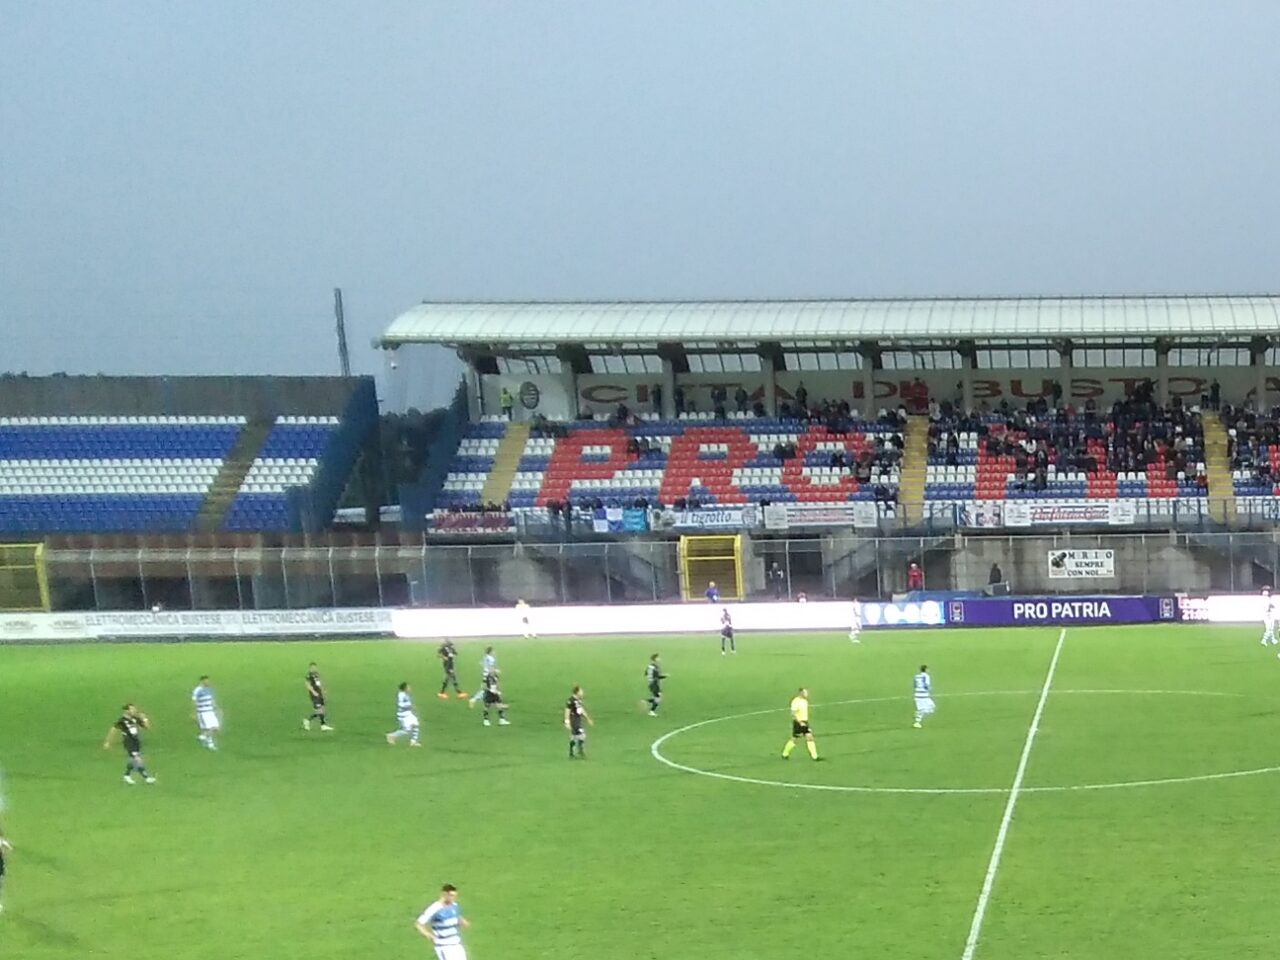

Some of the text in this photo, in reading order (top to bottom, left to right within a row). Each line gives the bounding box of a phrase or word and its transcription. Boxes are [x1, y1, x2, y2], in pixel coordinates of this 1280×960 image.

[534, 425, 873, 506] PRO
[691, 511, 732, 528] tigrotto
[1013, 602, 1111, 619] PRO PATRIA
